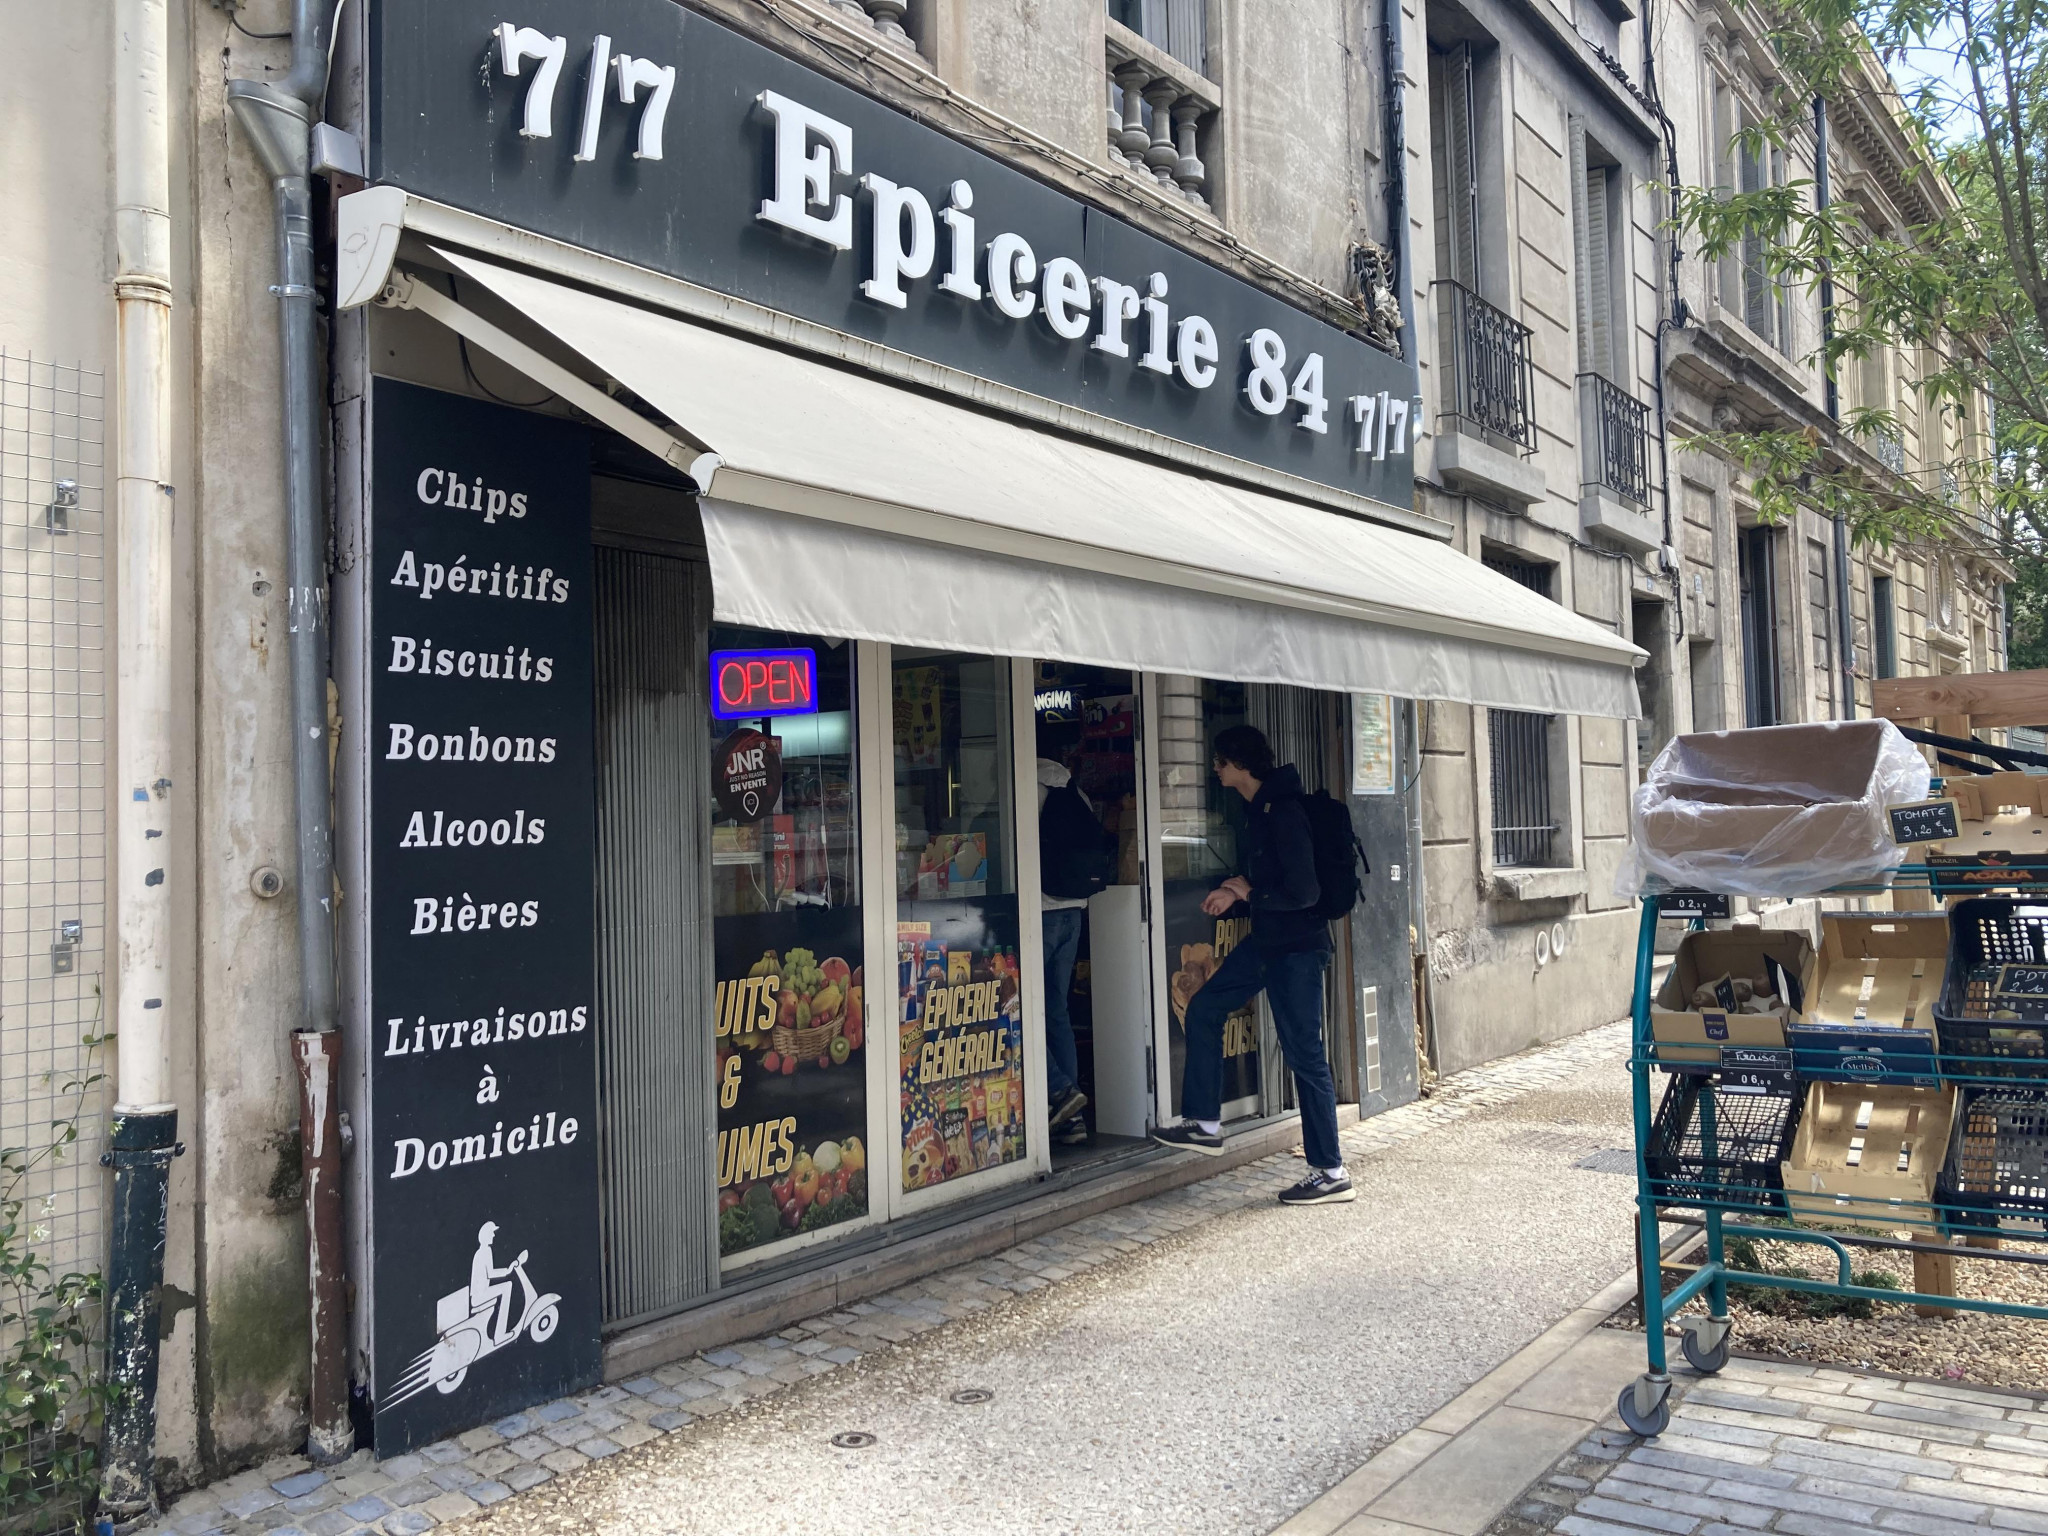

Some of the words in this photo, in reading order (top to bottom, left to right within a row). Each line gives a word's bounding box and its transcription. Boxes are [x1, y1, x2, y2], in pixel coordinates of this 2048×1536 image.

[498, 22, 676, 161] 7/7
[760, 89, 1219, 389] Epicerie
[1246, 328, 1328, 434] 84
[1354, 391, 1408, 460] 7/7
[416, 467, 528, 524] Chips
[390, 550, 570, 603] Apéritifs
[387, 635, 554, 682] Biscuits
[719, 660, 811, 705] OPEN
[386, 723, 557, 763] Bonbons
[726, 748, 766, 775] JNR
[730, 784, 741, 793] EN
[742, 778, 767, 790] VENTE
[399, 810, 546, 848] Alcools
[1894, 807, 1947, 821] TOMATE
[1903, 824, 1932, 837] 3,20
[410, 892, 539, 935] Bières
[923, 980, 1002, 1031] ÉPICERIE
[384, 1005, 587, 1056] Livraisons
[920, 1027, 1008, 1084] GÉNÉRALE
[476, 1064, 500, 1104] à
[720, 1055, 742, 1109] &
[390, 1111, 578, 1179] Domicile
